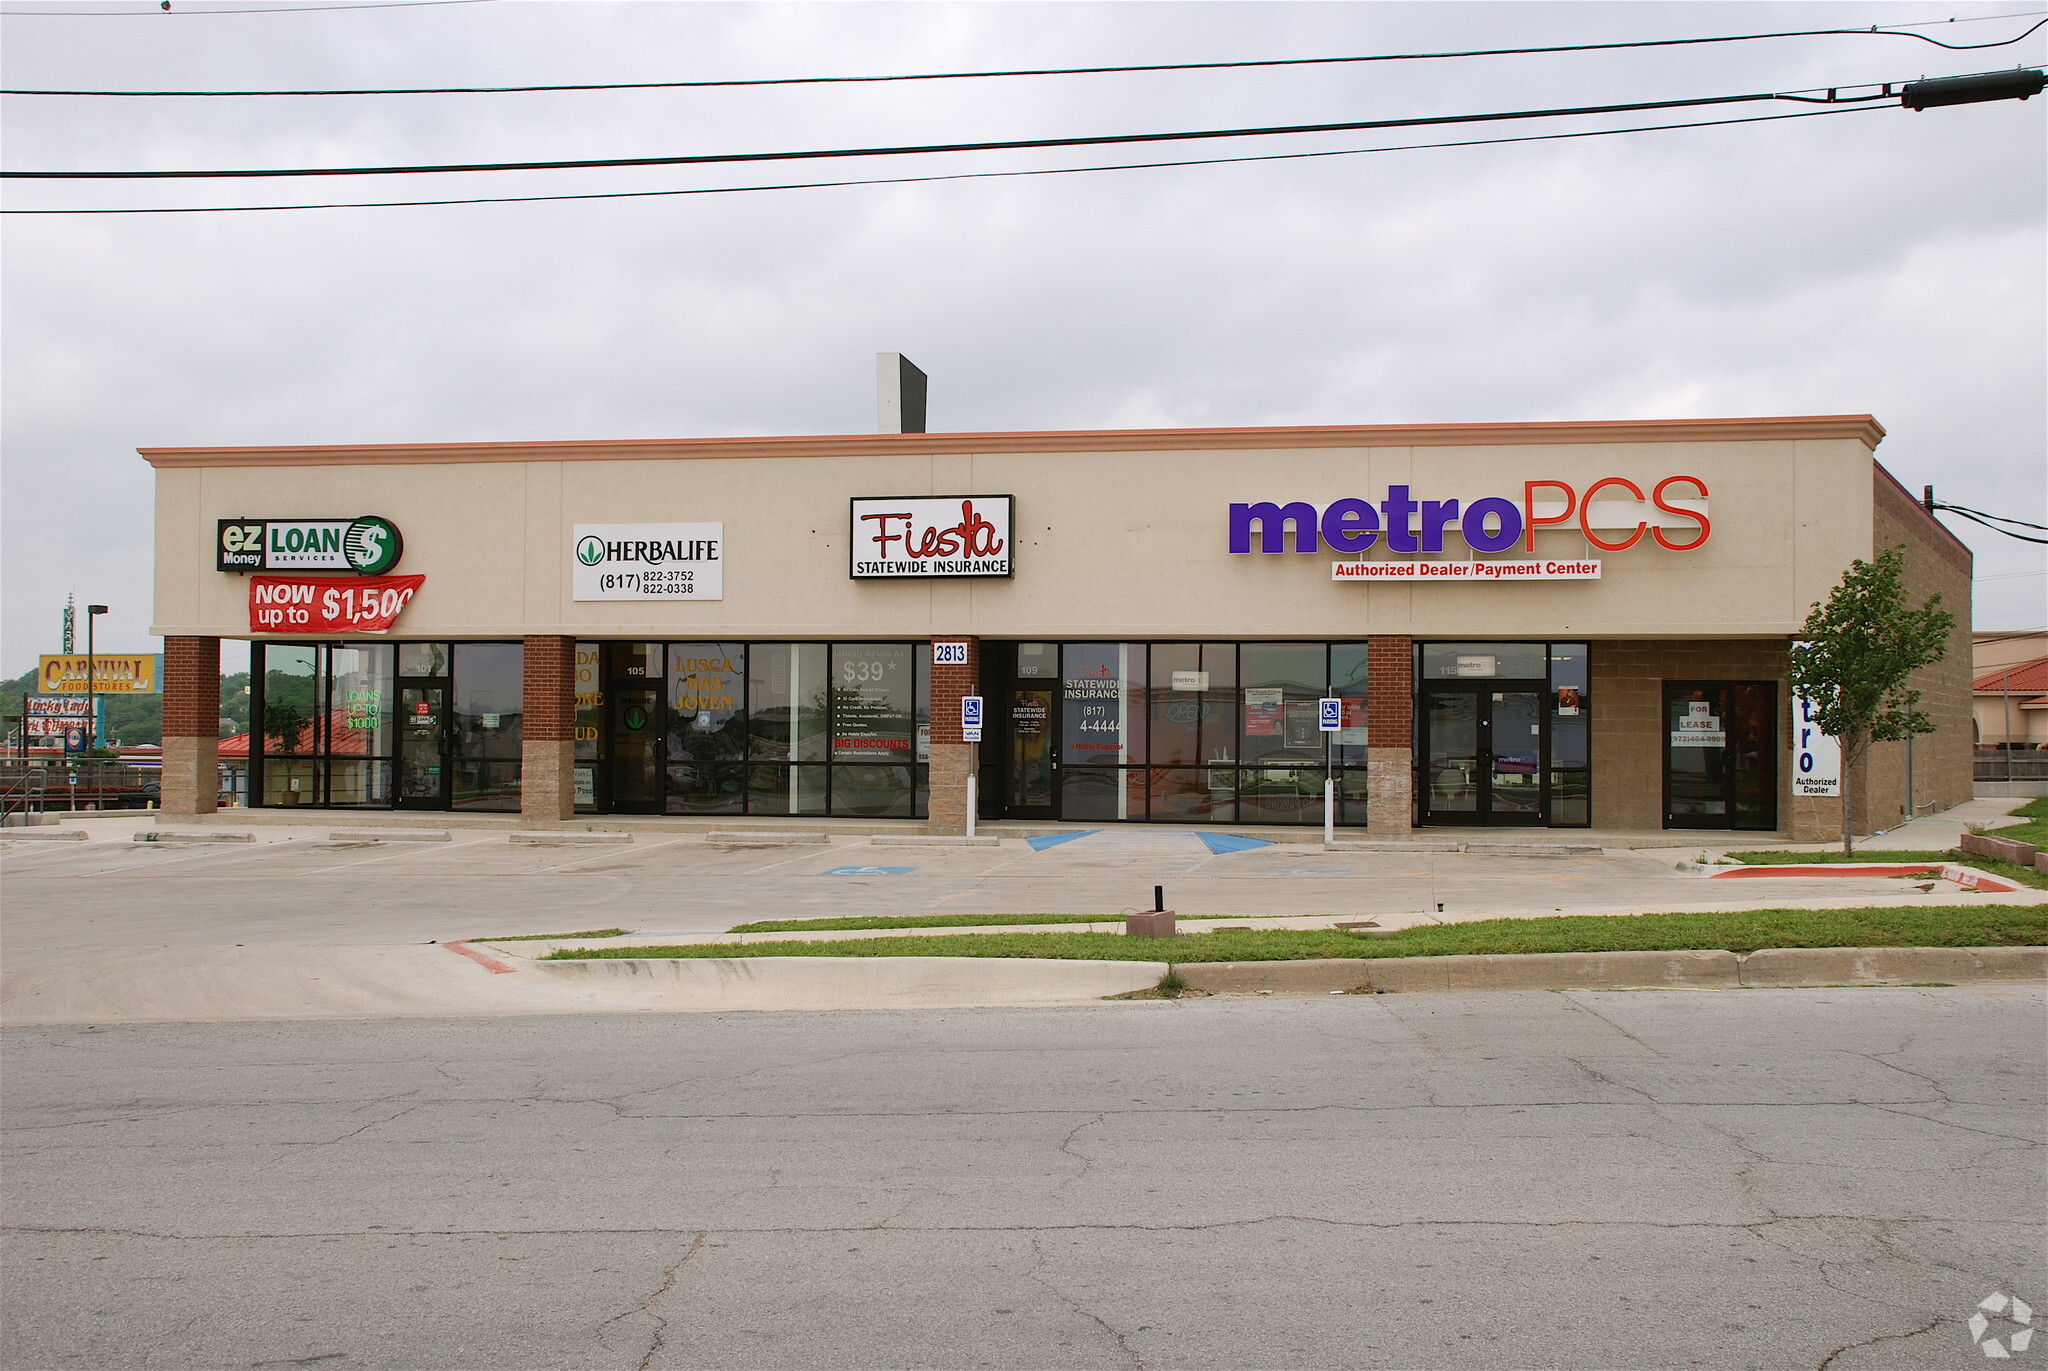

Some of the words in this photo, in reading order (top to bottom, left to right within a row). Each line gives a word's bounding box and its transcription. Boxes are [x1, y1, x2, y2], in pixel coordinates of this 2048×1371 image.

[1228, 475, 1712, 554] metroPCS
[860, 500, 1003, 559] Fiesta
[271, 528, 340, 553] LOAN
[223, 552, 261, 567] Money
[606, 540, 719, 565] HERBALIFE
[856, 561, 928, 574] STATEWIDE
[933, 560, 1007, 573] INSURANCE
[1335, 563, 1415, 576] Authorized
[1545, 561, 1598, 575] Center
[600, 573, 641, 592] (817)
[643, 571, 694, 581] 822-3752
[643, 583, 694, 594] 822-0338
[255, 584, 316, 604] NOW
[258, 608, 284, 628] up
[287, 605, 310, 624] to
[936, 645, 965, 661] 2813
[627, 666, 645, 675] 105
[675, 656, 734, 673] LUSCA
[1020, 666, 1038, 675] 109
[1439, 666, 1457, 675] 115
[45, 660, 149, 690] CARNIVAL
[62, 683, 88, 691] FOOD
[93, 683, 131, 691] STORES
[686, 677, 723, 691] MAS
[345, 689, 382, 702] LOANS
[674, 695, 734, 710] JOVEN
[347, 703, 362, 715] UP
[364, 703, 380, 716] TO
[1083, 706, 1105, 717] (817)
[347, 716, 379, 730] $1000
[1680, 721, 1712, 729] LEASE
[834, 738, 851, 749] BIG
[853, 738, 909, 749] DISCOUNTS
[1795, 777, 1837, 786] Authorized
[1803, 786, 1829, 794] Dealer
[146, 832, 159, 842] EZ
